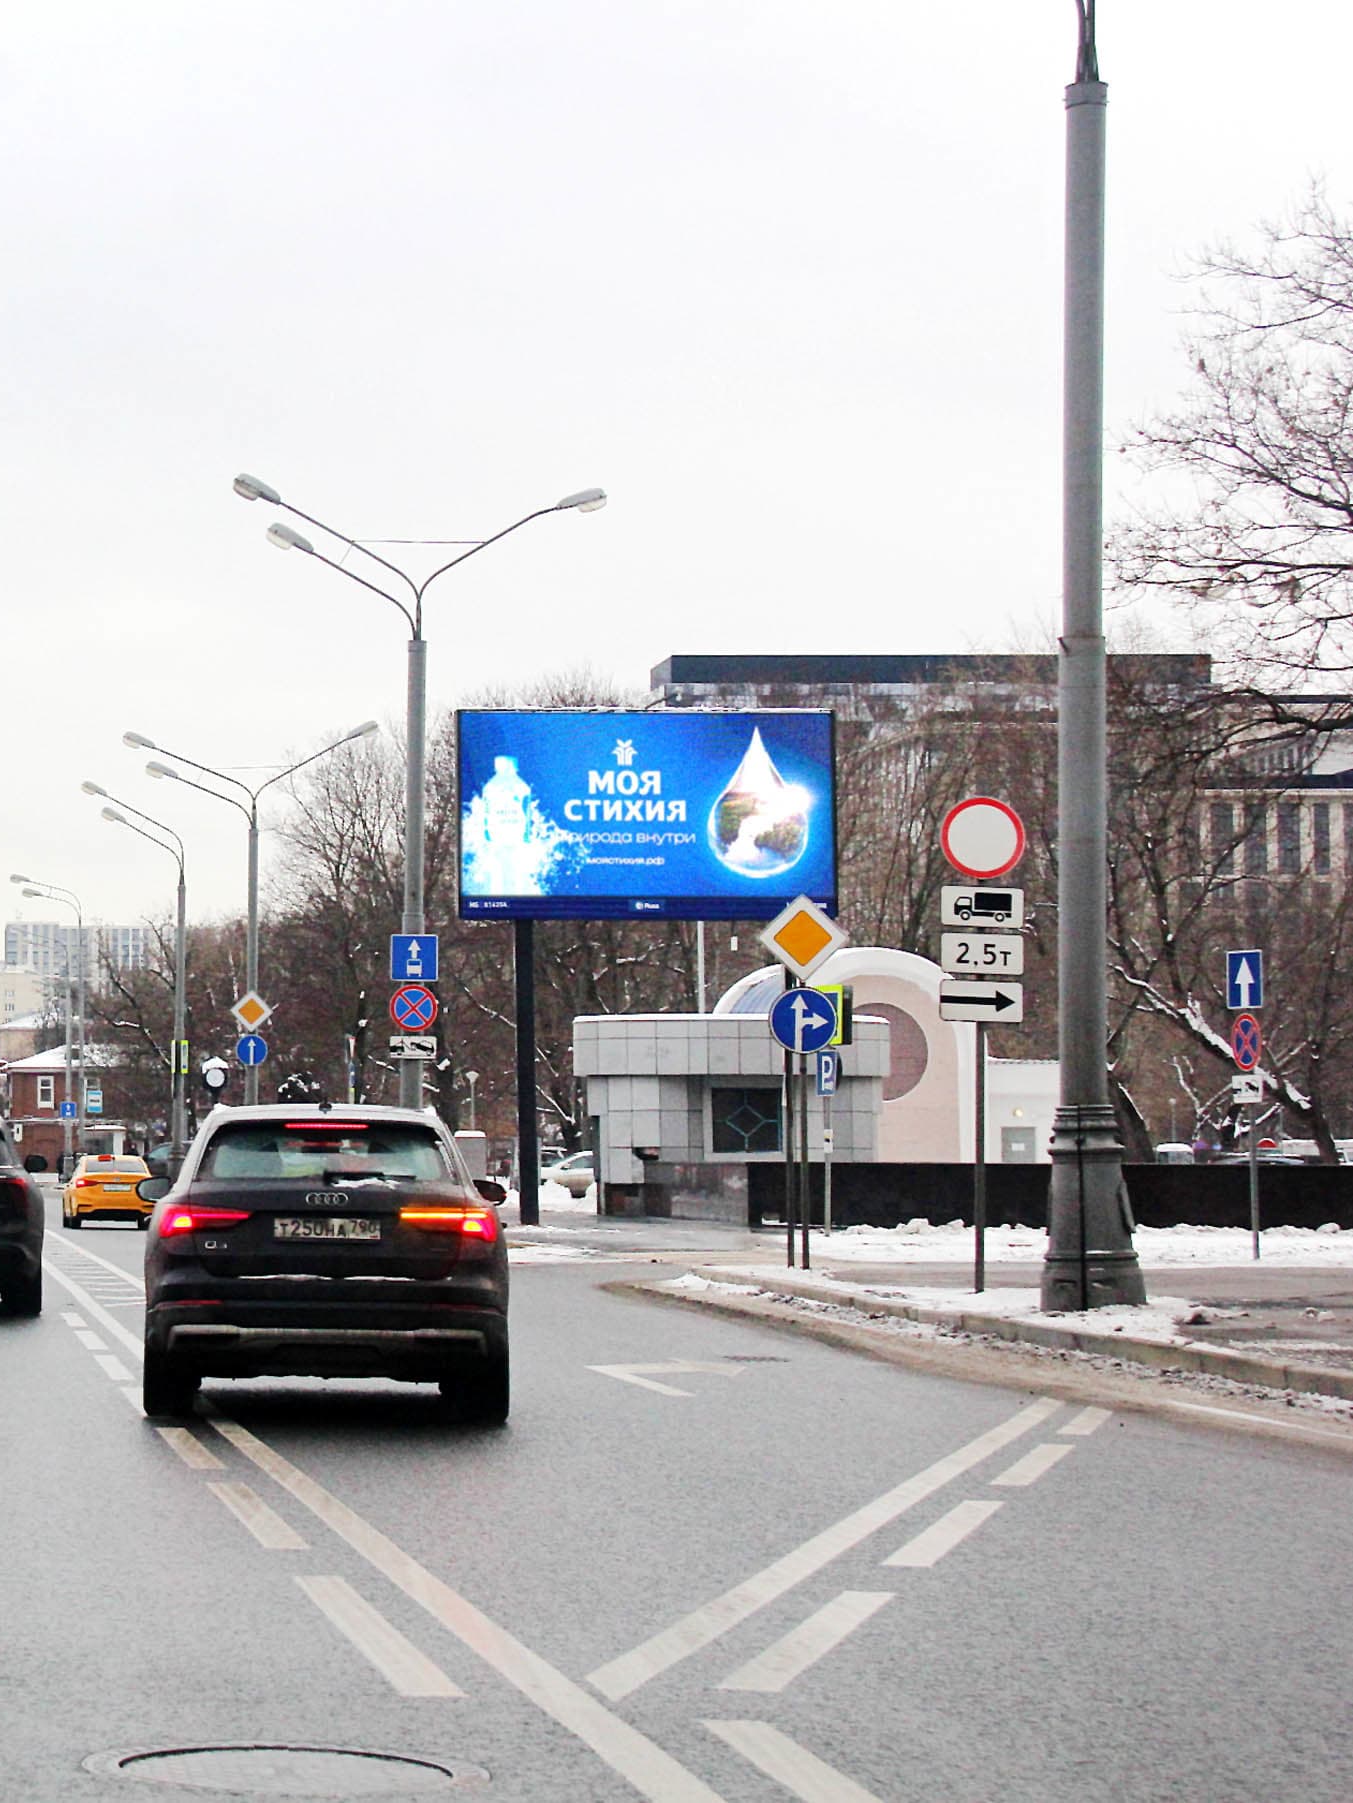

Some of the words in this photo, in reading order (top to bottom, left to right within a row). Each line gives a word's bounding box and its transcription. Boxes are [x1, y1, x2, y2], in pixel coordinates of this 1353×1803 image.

[588, 770, 661, 795] МОЯ
[564, 799, 686, 821] СТИХИЯ
[557, 831, 632, 845] рирода
[636, 832, 696, 846] внутри
